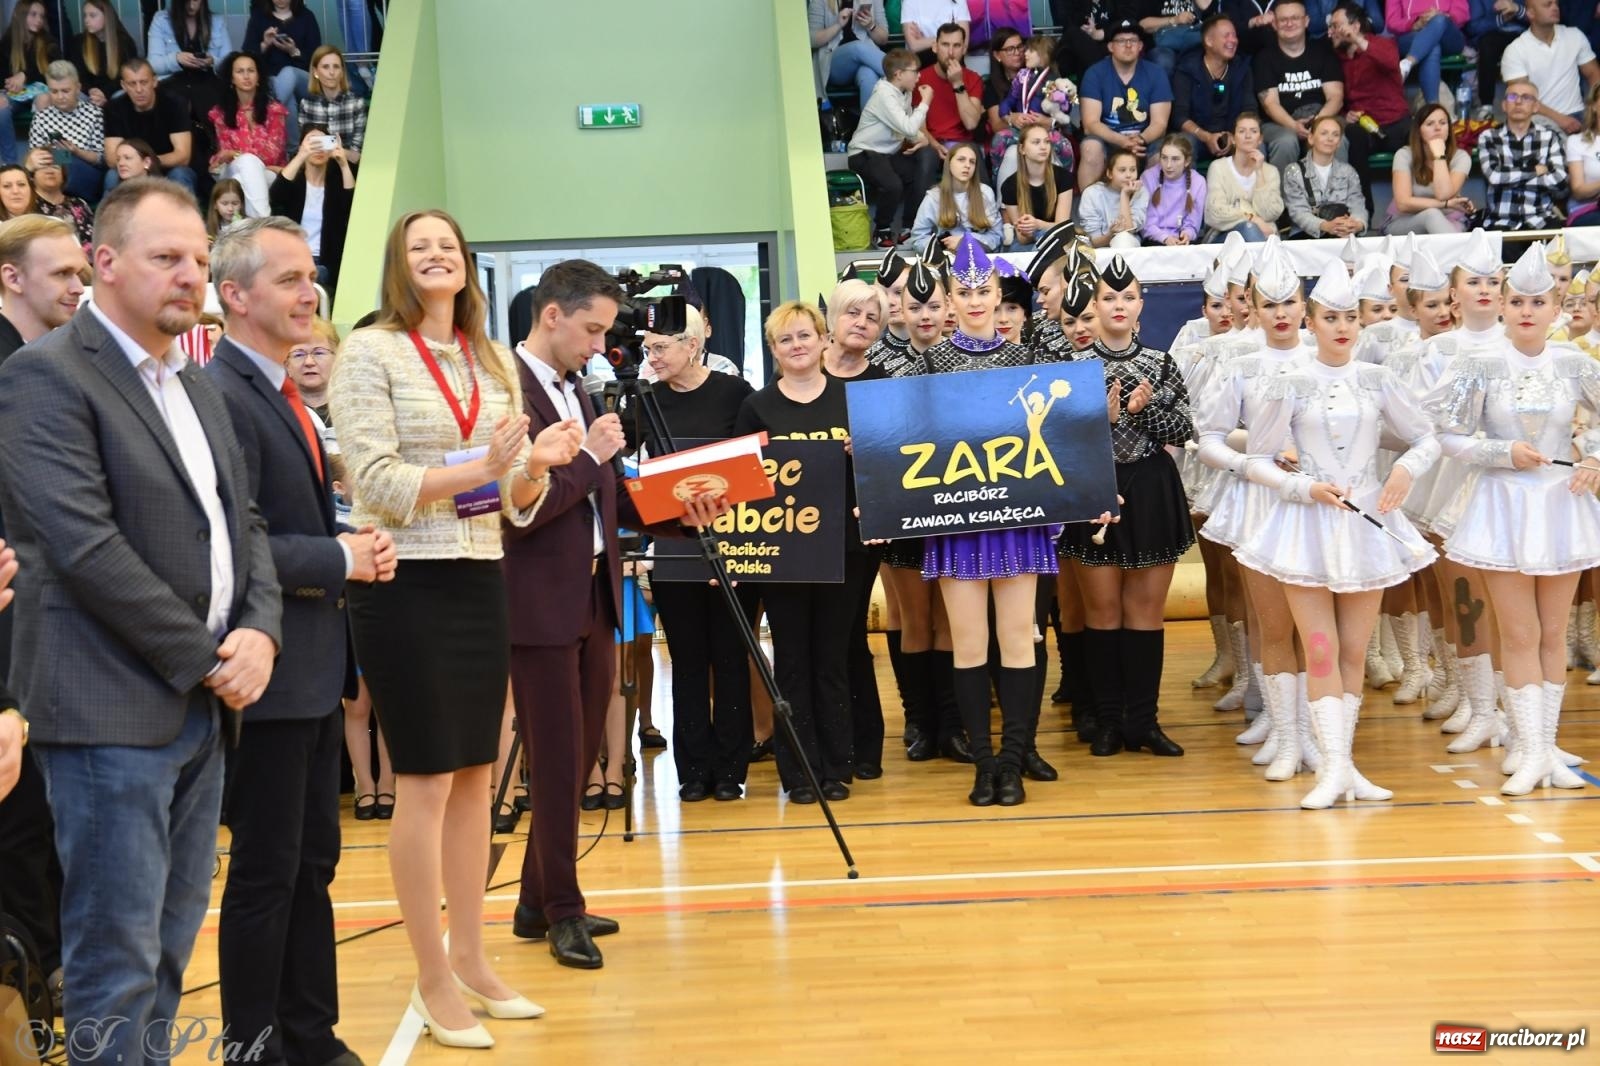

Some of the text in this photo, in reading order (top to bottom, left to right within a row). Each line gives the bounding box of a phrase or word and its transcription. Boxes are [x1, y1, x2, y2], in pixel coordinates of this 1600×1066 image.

[1285, 70, 1311, 82] TATA
[762, 458, 802, 486] ec
[900, 436, 1065, 490] ZARA
[933, 486, 1009, 505] RACIBÓRZ
[698, 495, 821, 534] abcie
[902, 506, 1046, 530] ZAWADA KSIĄŻĘCA
[718, 541, 780, 556] Racibórz
[725, 558, 772, 574] Polska
